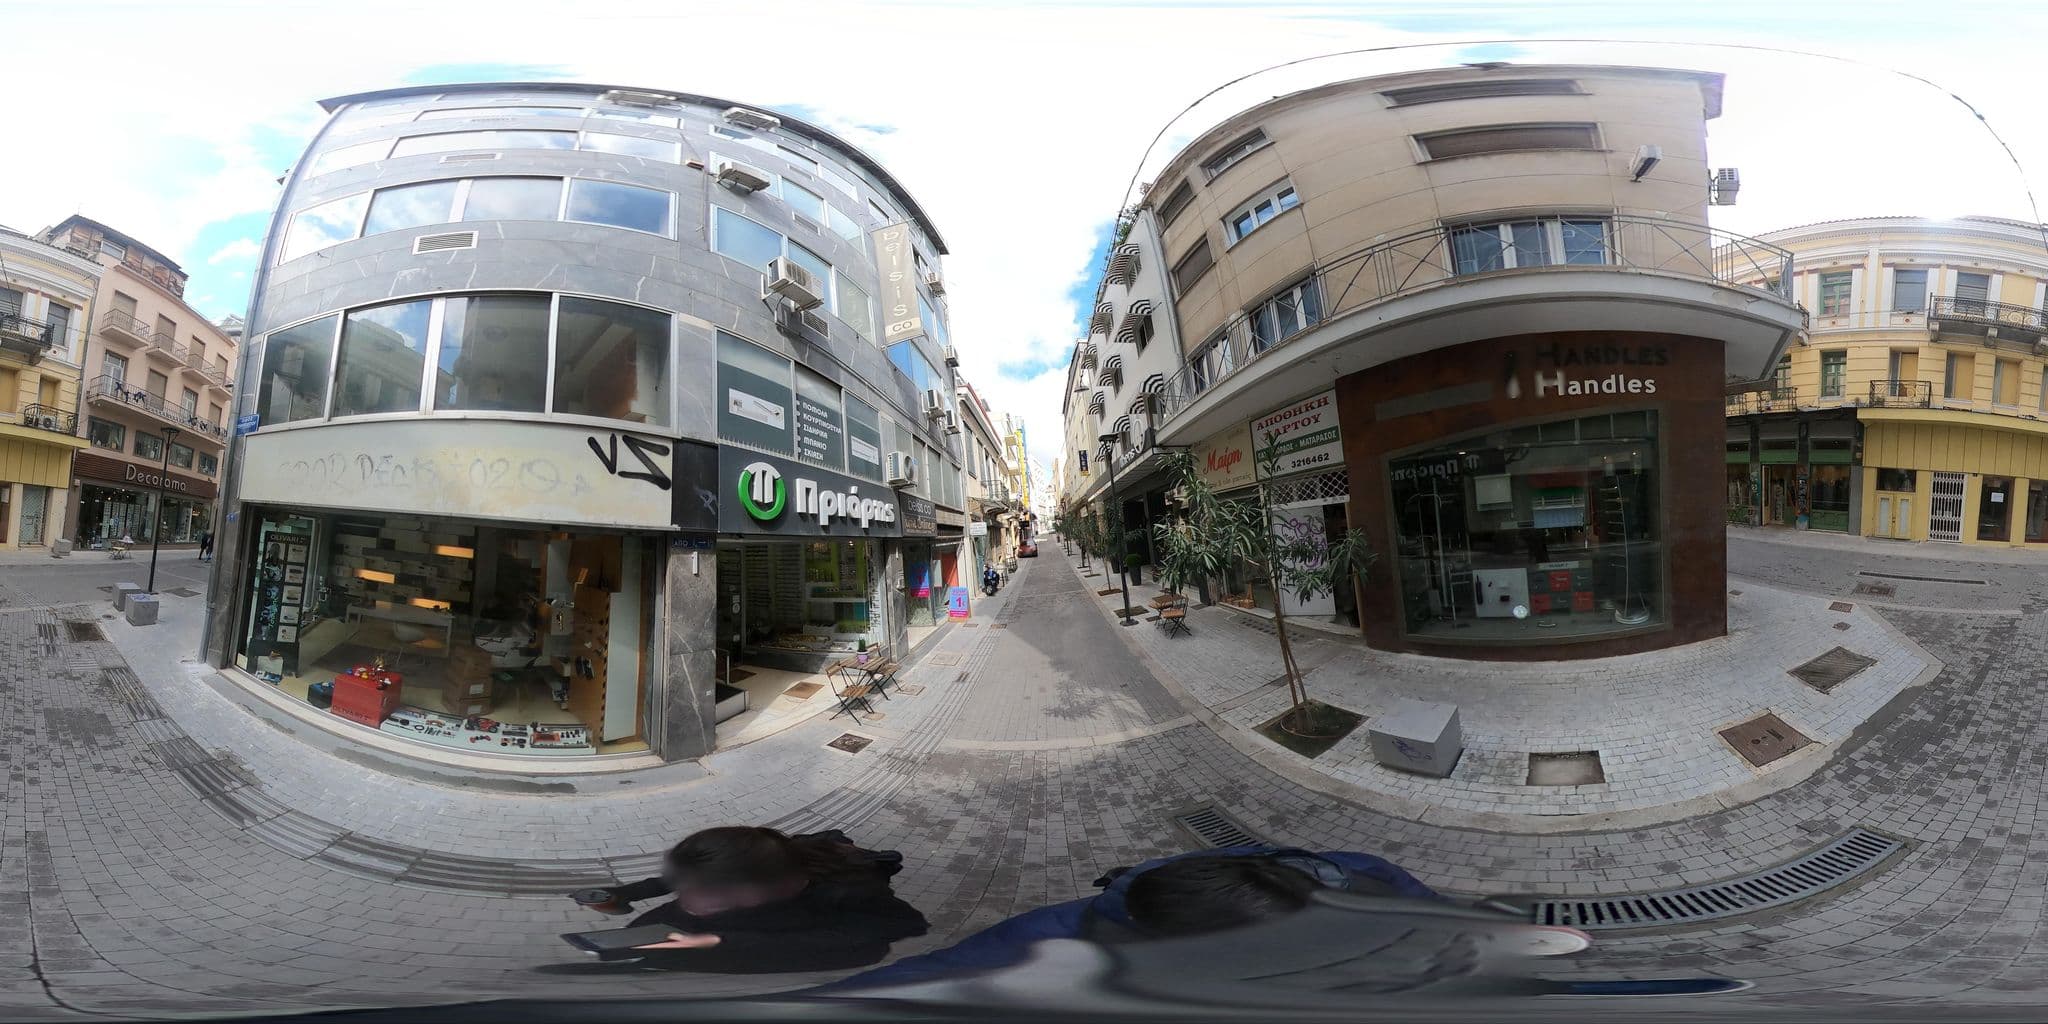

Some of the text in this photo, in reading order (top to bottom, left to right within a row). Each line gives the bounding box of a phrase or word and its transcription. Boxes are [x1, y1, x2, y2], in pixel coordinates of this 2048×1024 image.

[1535, 370, 1656, 397] Handles
[1257, 396, 1329, 430] ΑΠΟΘΗΚΗ
[1292, 452, 1329, 468] 3216462
[125, 464, 187, 491] Decorama
[796, 477, 895, 528] Πριάρης
